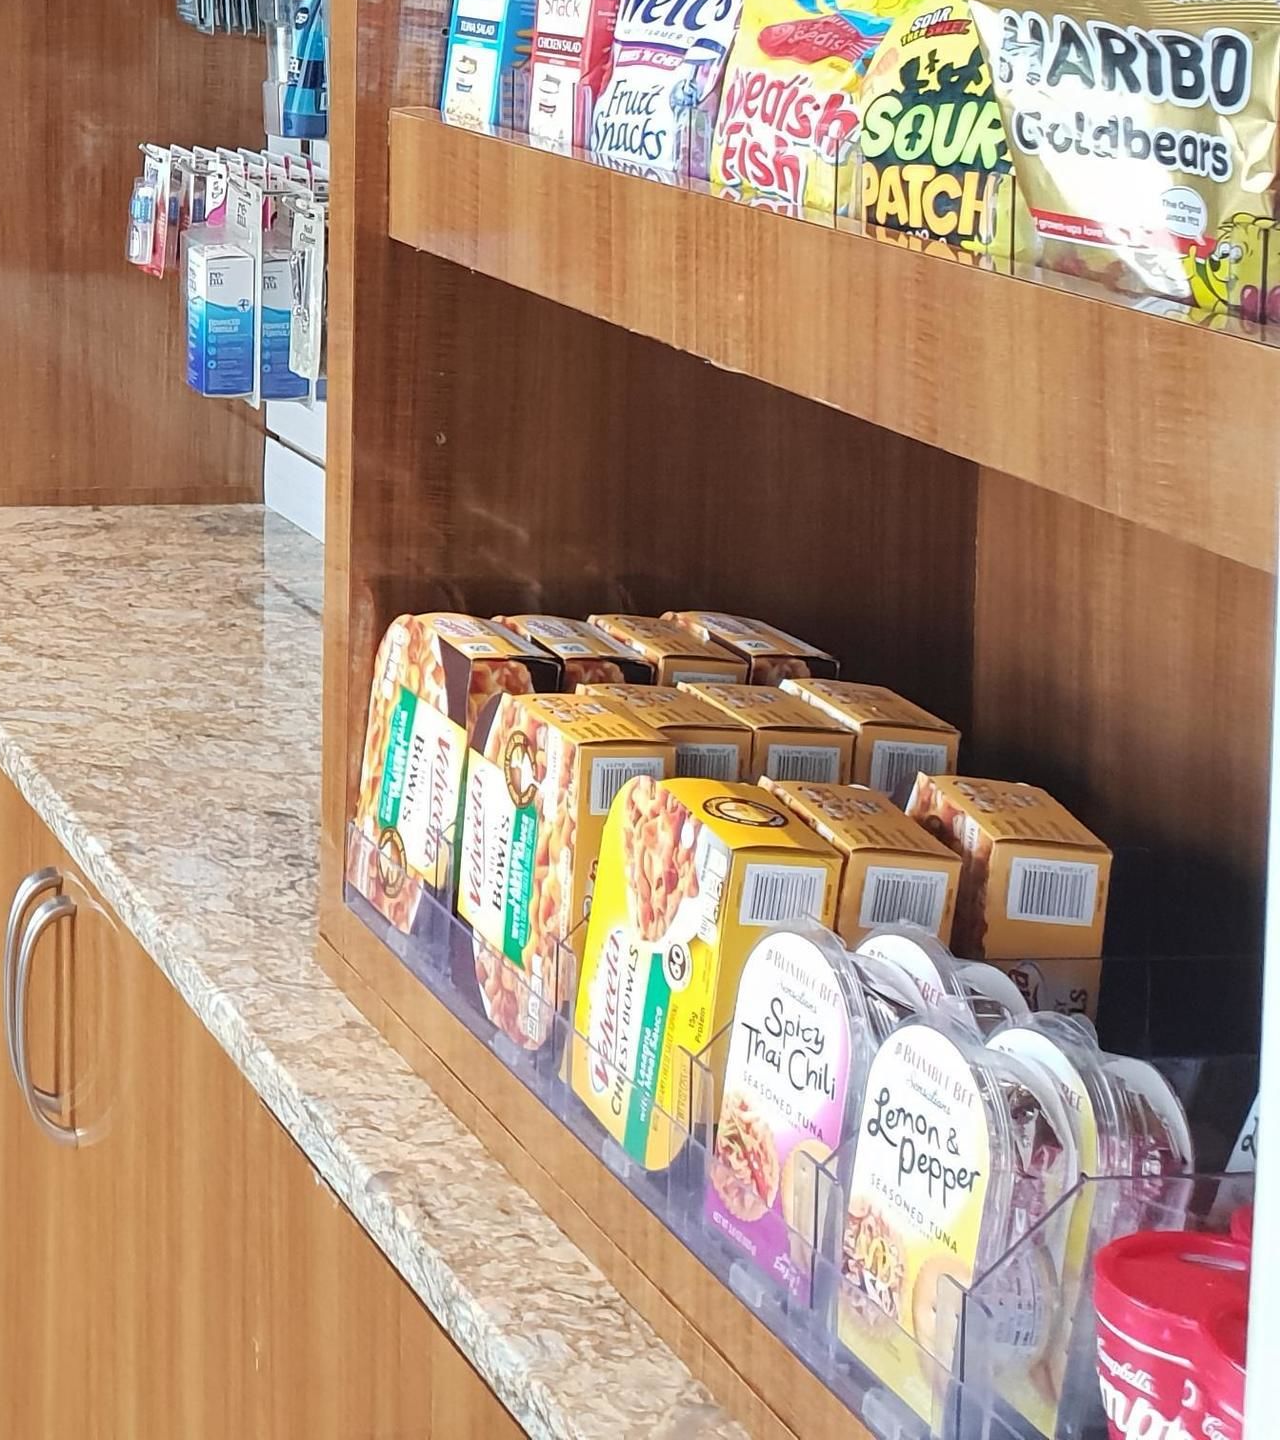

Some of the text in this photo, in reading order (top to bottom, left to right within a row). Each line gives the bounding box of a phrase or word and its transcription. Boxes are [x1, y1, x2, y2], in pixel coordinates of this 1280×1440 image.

[561, 39, 582, 54] SALAD
[911, 7, 952, 32] SOUR
[594, 110, 667, 161] Snacks
[609, 78, 665, 118] Fruit
[861, 95, 1006, 170] SOUR
[724, 121, 804, 204] Fish
[862, 162, 997, 237] PATCH
[400, 732, 427, 823] BOWLS
[423, 734, 451, 869] Velveeta
[468, 767, 486, 909] Velveeta
[491, 814, 512, 913] BOWLS
[592, 933, 621, 1087] Velveeta
[764, 996, 825, 1055] Spicy
[741, 1021, 836, 1102] Thai Chili
[743, 1071, 824, 1142] SEASONED TUNA
[866, 1087, 961, 1156] Lemon &
[897, 1136, 982, 1209] Pepper
[870, 1172, 958, 1255] SEASONED TUNA
